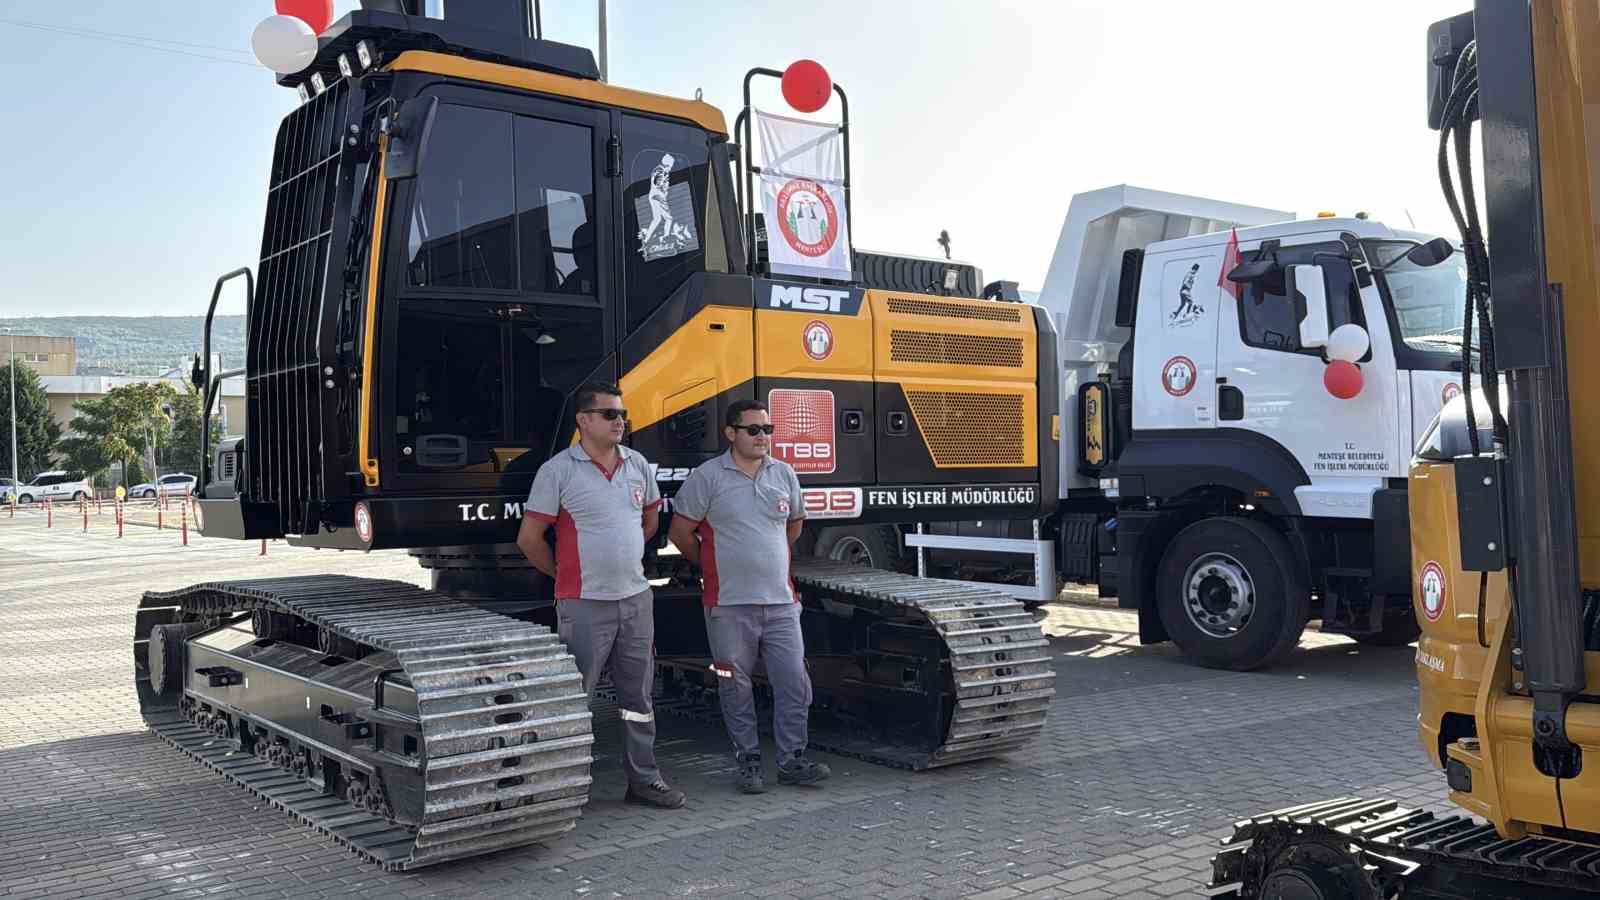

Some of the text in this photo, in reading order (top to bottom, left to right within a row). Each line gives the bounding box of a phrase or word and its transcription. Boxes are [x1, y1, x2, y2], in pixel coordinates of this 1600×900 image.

[770, 285, 850, 312] MST
[775, 443, 831, 458] TBB
[801, 490, 856, 511] BB
[869, 487, 1035, 509] FEN İŞLERİ MÜDÜRLÜĞÜ
[458, 503, 496, 521] T.C.
